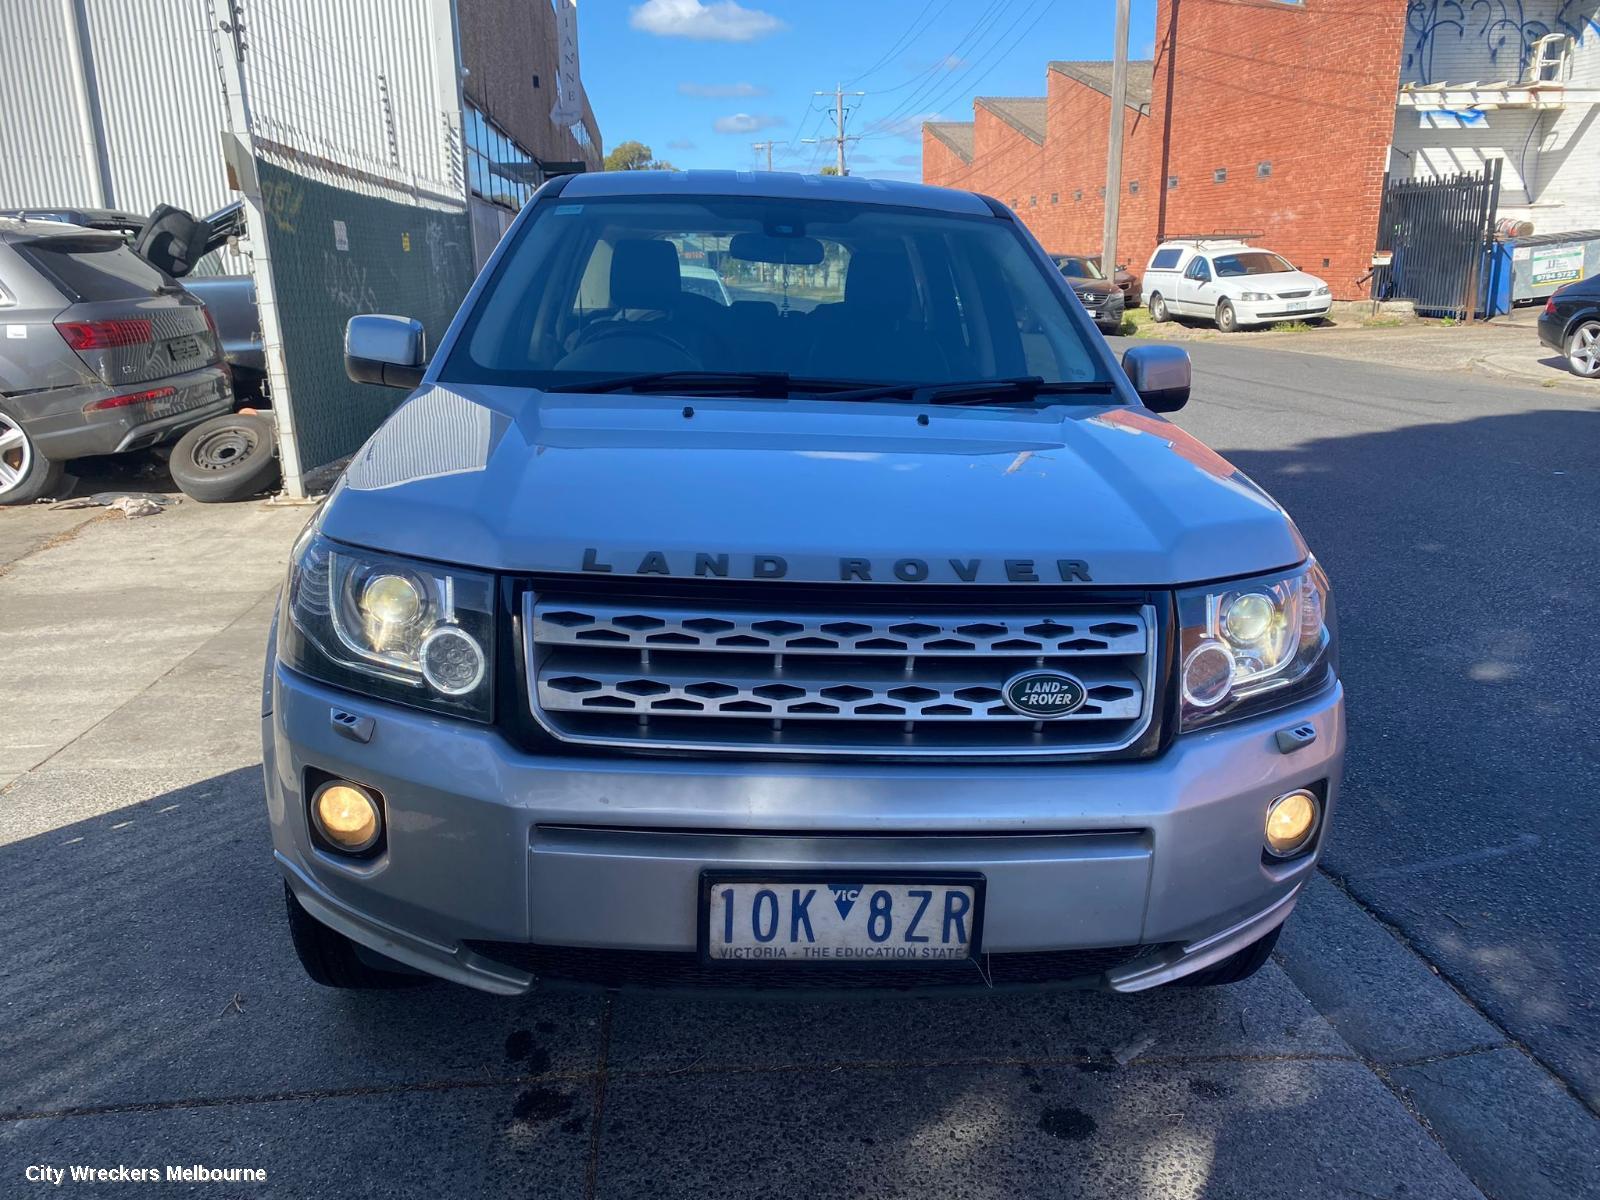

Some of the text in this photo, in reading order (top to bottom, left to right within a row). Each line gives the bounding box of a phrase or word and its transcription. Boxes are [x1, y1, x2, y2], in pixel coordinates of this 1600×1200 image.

[582, 548, 1093, 582] LAND ROVER
[1025, 682, 1060, 693] LAND
[1028, 693, 1072, 705] ROVER
[721, 888, 971, 944] 10K 8ZR
[720, 947, 787, 959] VICTORIA
[804, 947, 830, 958] THE
[835, 947, 915, 959] EDUCATION
[920, 947, 964, 959] STATE
